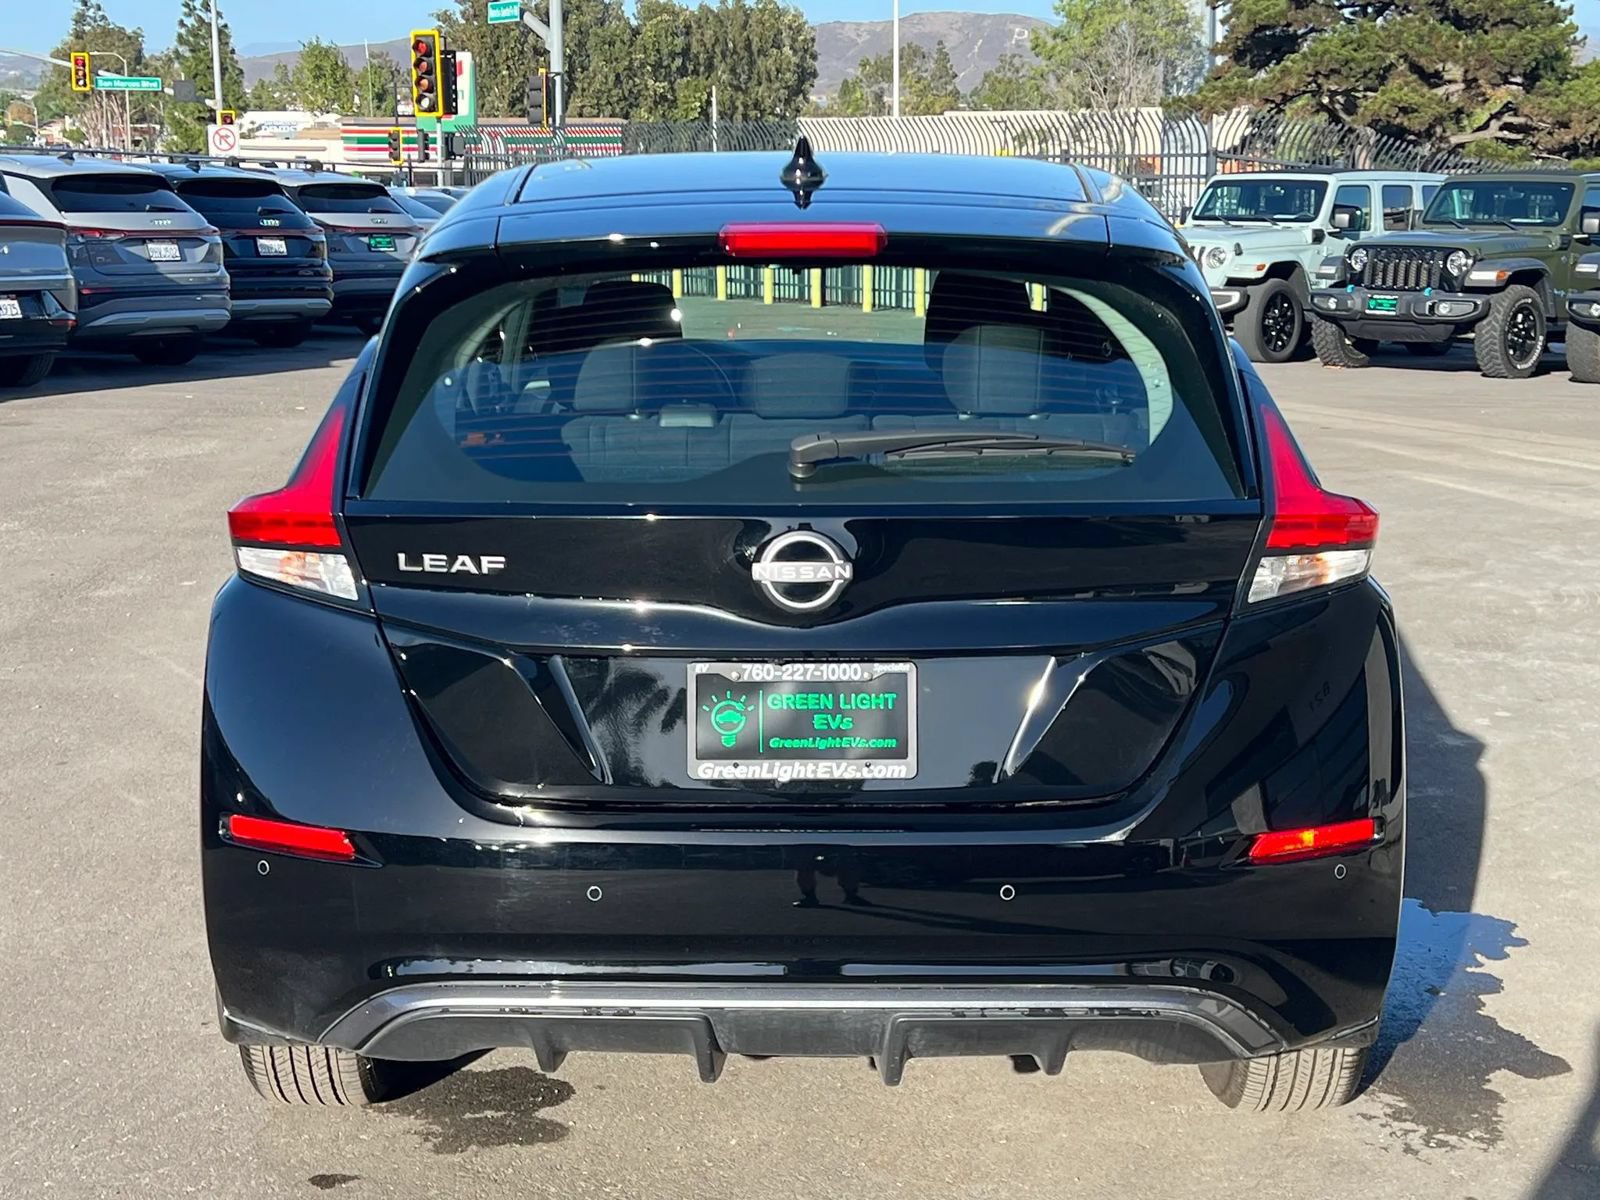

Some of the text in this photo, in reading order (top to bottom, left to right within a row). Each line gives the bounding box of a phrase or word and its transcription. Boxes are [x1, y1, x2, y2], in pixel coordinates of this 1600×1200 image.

[397, 552, 506, 574] LEAF
[752, 562, 853, 581] NISSAN
[741, 663, 862, 681] 760-227-1000
[766, 692, 897, 710] GREEN LIGHT
[812, 713, 853, 730] EVs
[768, 736, 897, 751] GreenLightEVs.com
[697, 761, 908, 782] GreenLightEVs.com
